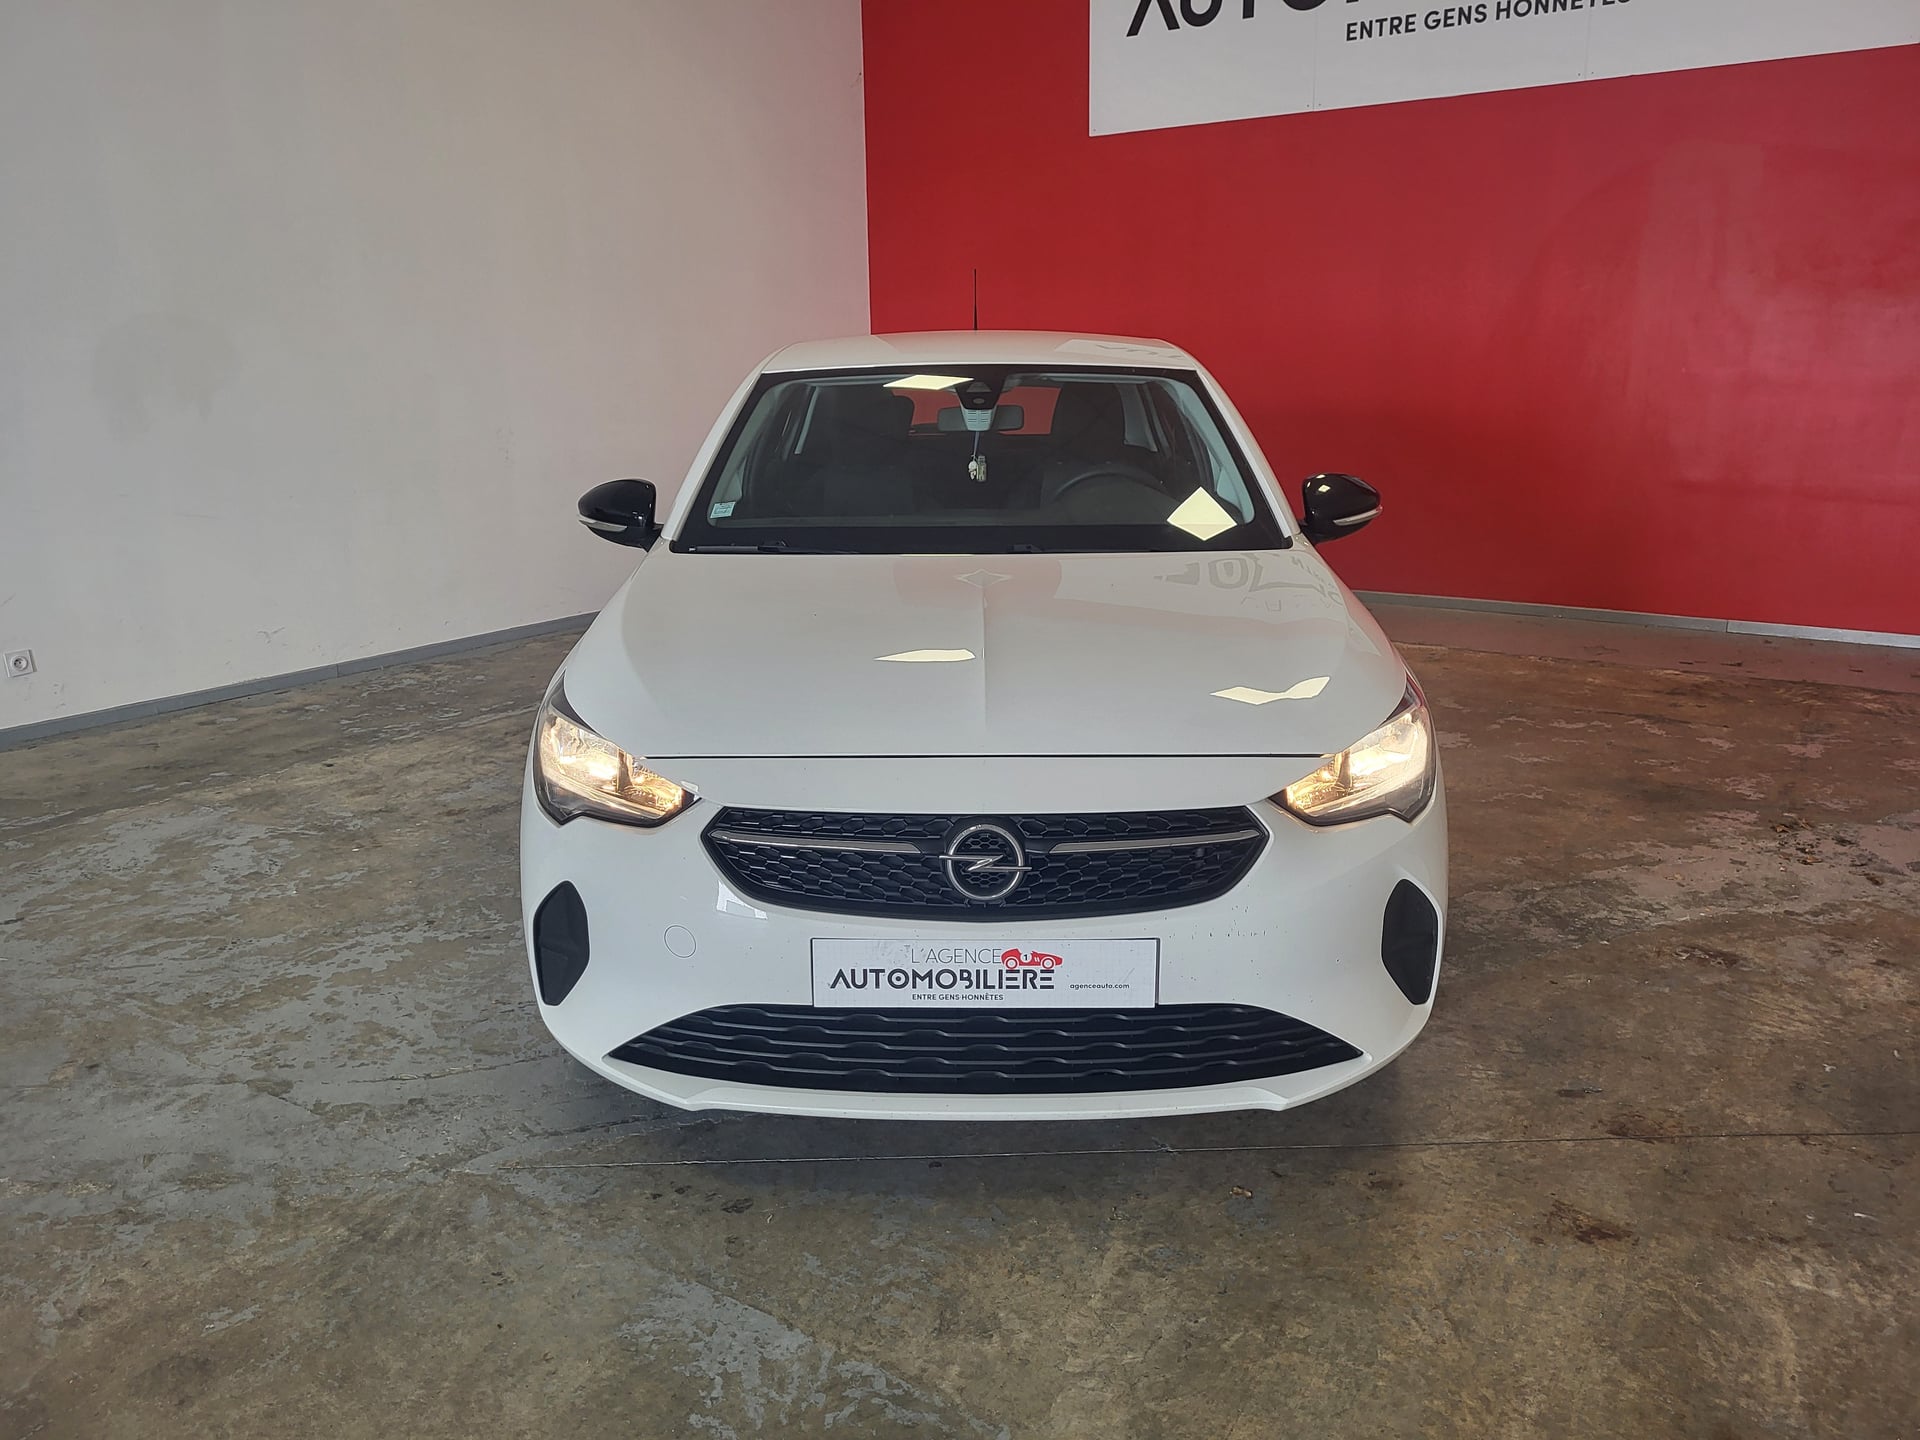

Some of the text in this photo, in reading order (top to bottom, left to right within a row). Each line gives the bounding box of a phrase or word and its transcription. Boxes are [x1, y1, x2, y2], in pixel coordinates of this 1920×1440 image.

[1345, 13, 1417, 42] ENTRE
[1423, 3, 1488, 30] GENS
[1495, 0, 1630, 21] HONN
[911, 948, 1002, 964] L'AGENCE
[1069, 983, 1130, 991] agenceauto.com
[912, 992, 1004, 1001] ENTRE GENS HONNÊTES
